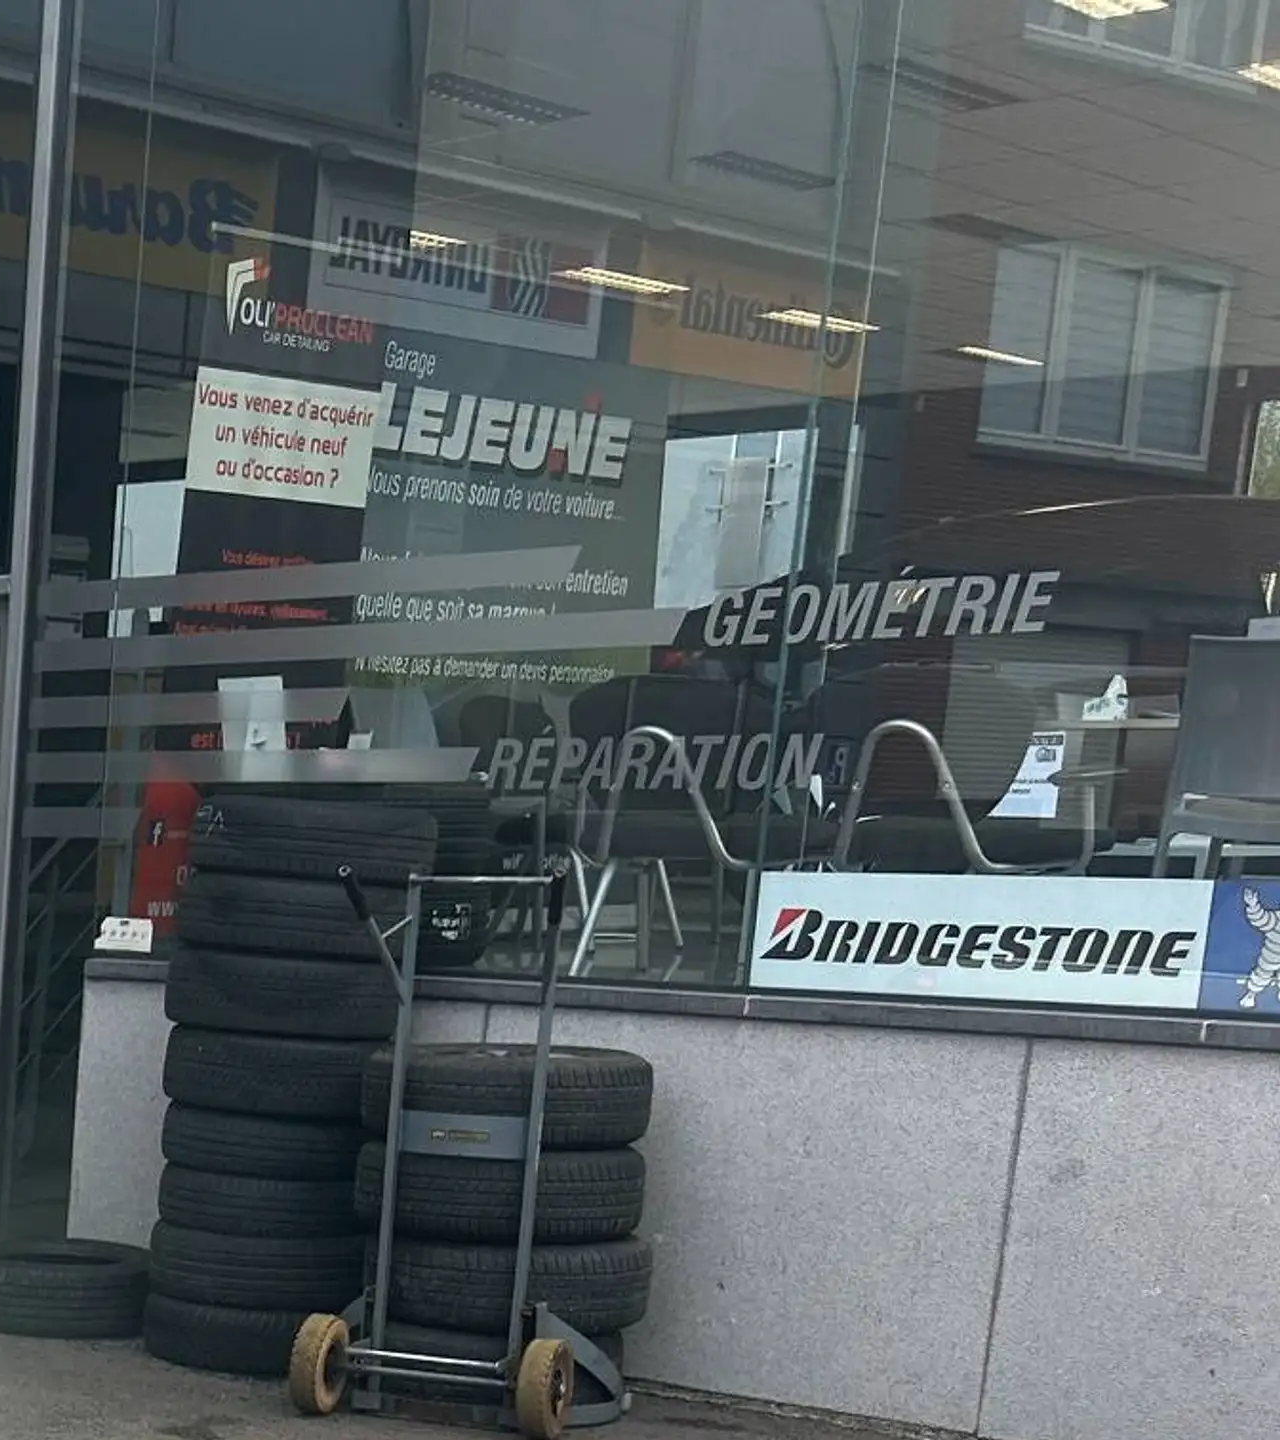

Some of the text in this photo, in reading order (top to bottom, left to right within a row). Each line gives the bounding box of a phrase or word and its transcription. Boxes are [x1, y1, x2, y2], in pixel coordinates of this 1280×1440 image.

[384, 340, 436, 379] Garage
[198, 383, 374, 428] Vous venez d'acquérir
[215, 424, 348, 458] un véhicule neuf
[372, 380, 633, 480] LEJEUNE
[216, 459, 339, 488] ou d'occasion ?
[403, 476, 464, 502] prenons
[468, 479, 500, 508] soin
[503, 483, 520, 510] de
[527, 489, 562, 515] votre
[566, 568, 628, 597] entretien
[406, 597, 432, 622] que
[410, 658, 431, 679] pas
[443, 658, 500, 680] demander
[486, 724, 824, 790] RÉPARATION
[760, 908, 1197, 977] BRIDGESTONE
